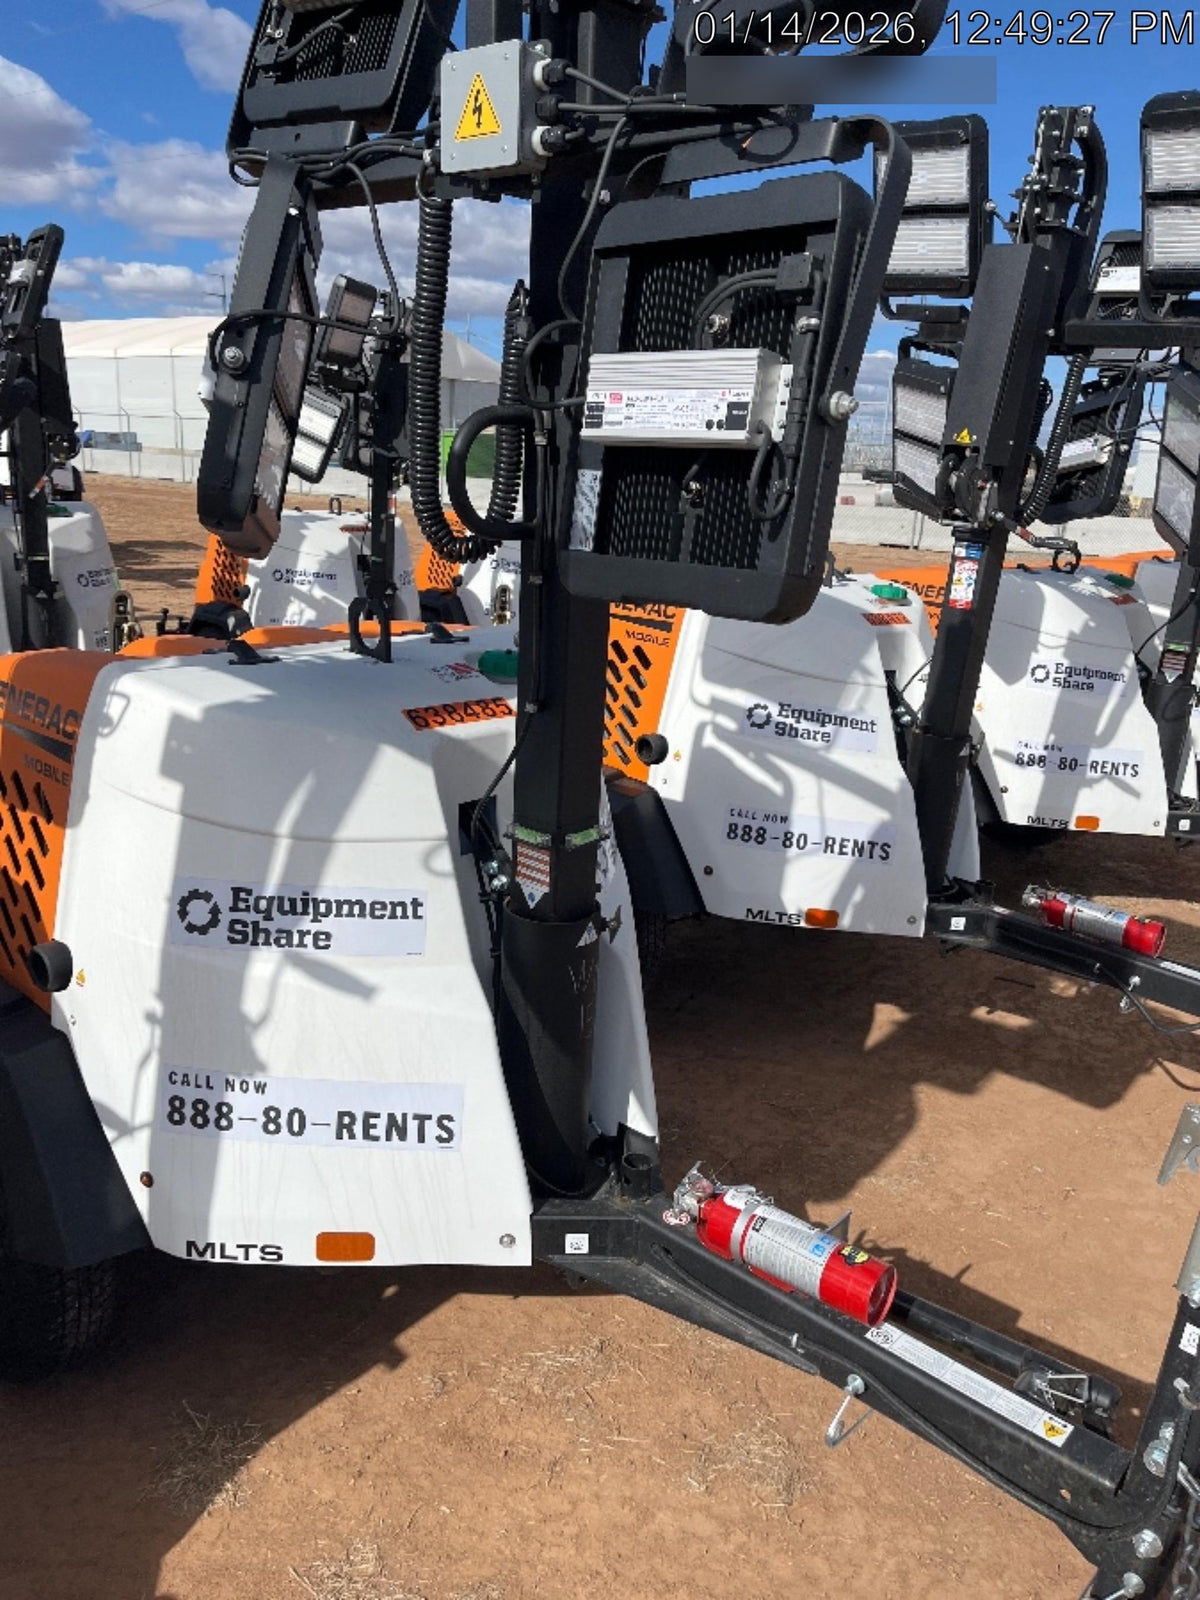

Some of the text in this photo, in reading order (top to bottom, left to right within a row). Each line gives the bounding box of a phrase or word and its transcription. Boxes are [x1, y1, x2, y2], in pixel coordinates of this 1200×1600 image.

[407, 697, 513, 729] 638485
[777, 702, 877, 733] Equipment
[774, 721, 831, 743] Share
[24, 754, 70, 787] MOBILE
[726, 822, 892, 861] 888-80-RENTS
[229, 887, 423, 923] Equipment
[745, 908, 802, 925] MLTS
[227, 919, 332, 950] Share
[168, 1071, 268, 1095] CALL NOW
[167, 1095, 456, 1144] 888-80-RENTS
[186, 1240, 283, 1262] MLTS
